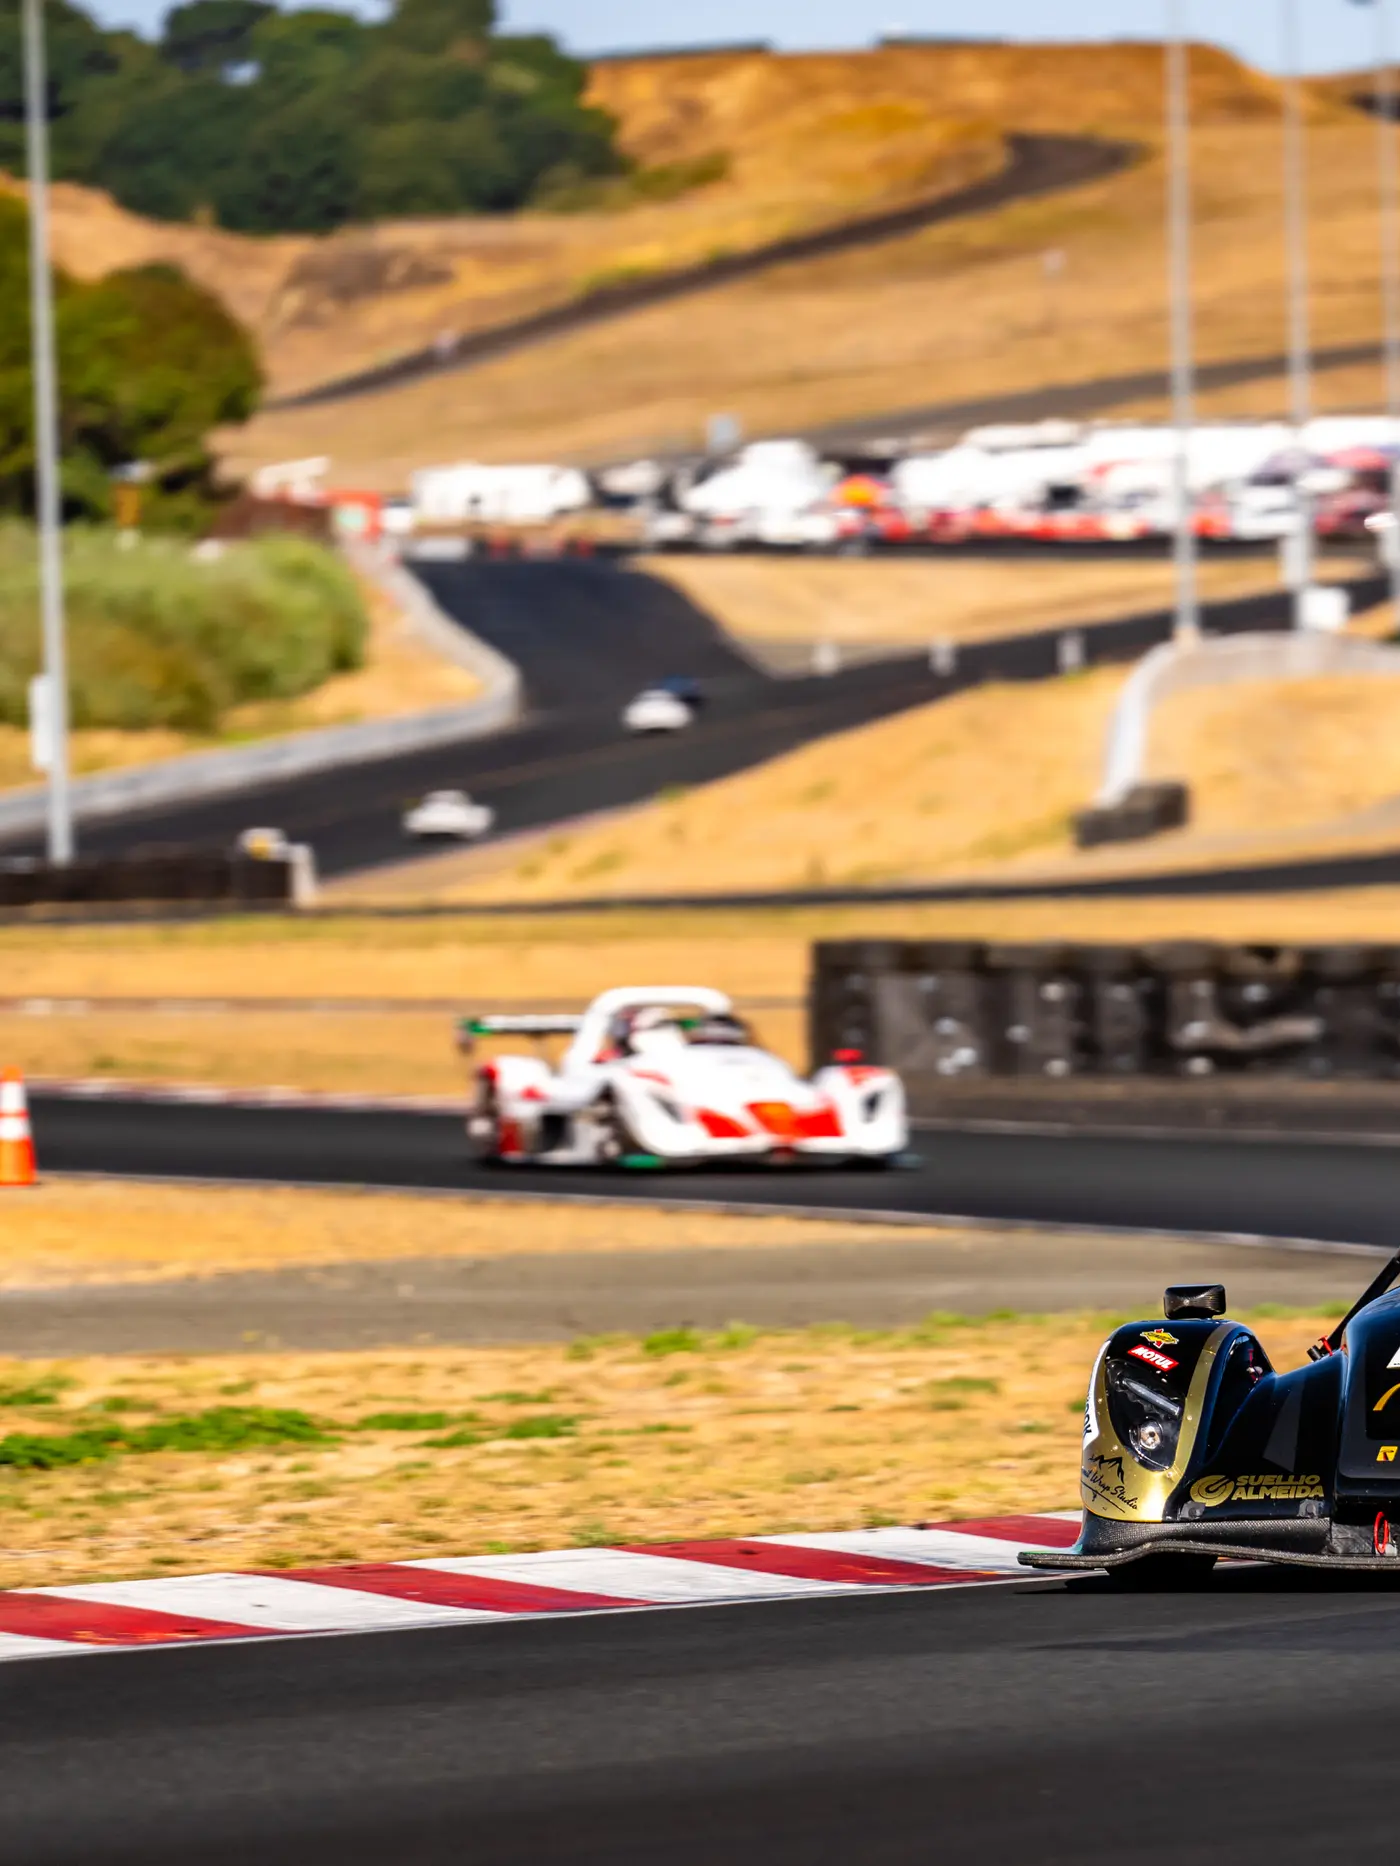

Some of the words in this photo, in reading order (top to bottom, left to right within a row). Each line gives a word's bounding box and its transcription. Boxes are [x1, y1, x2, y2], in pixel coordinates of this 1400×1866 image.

[1131, 1347, 1174, 1369] MOTUL
[1235, 1475, 1320, 1486] SUELLIO
[1089, 1471, 1111, 1493] Wrap
[1110, 1485, 1138, 1510] Studio
[1231, 1486, 1325, 1500] ALMEIDA
